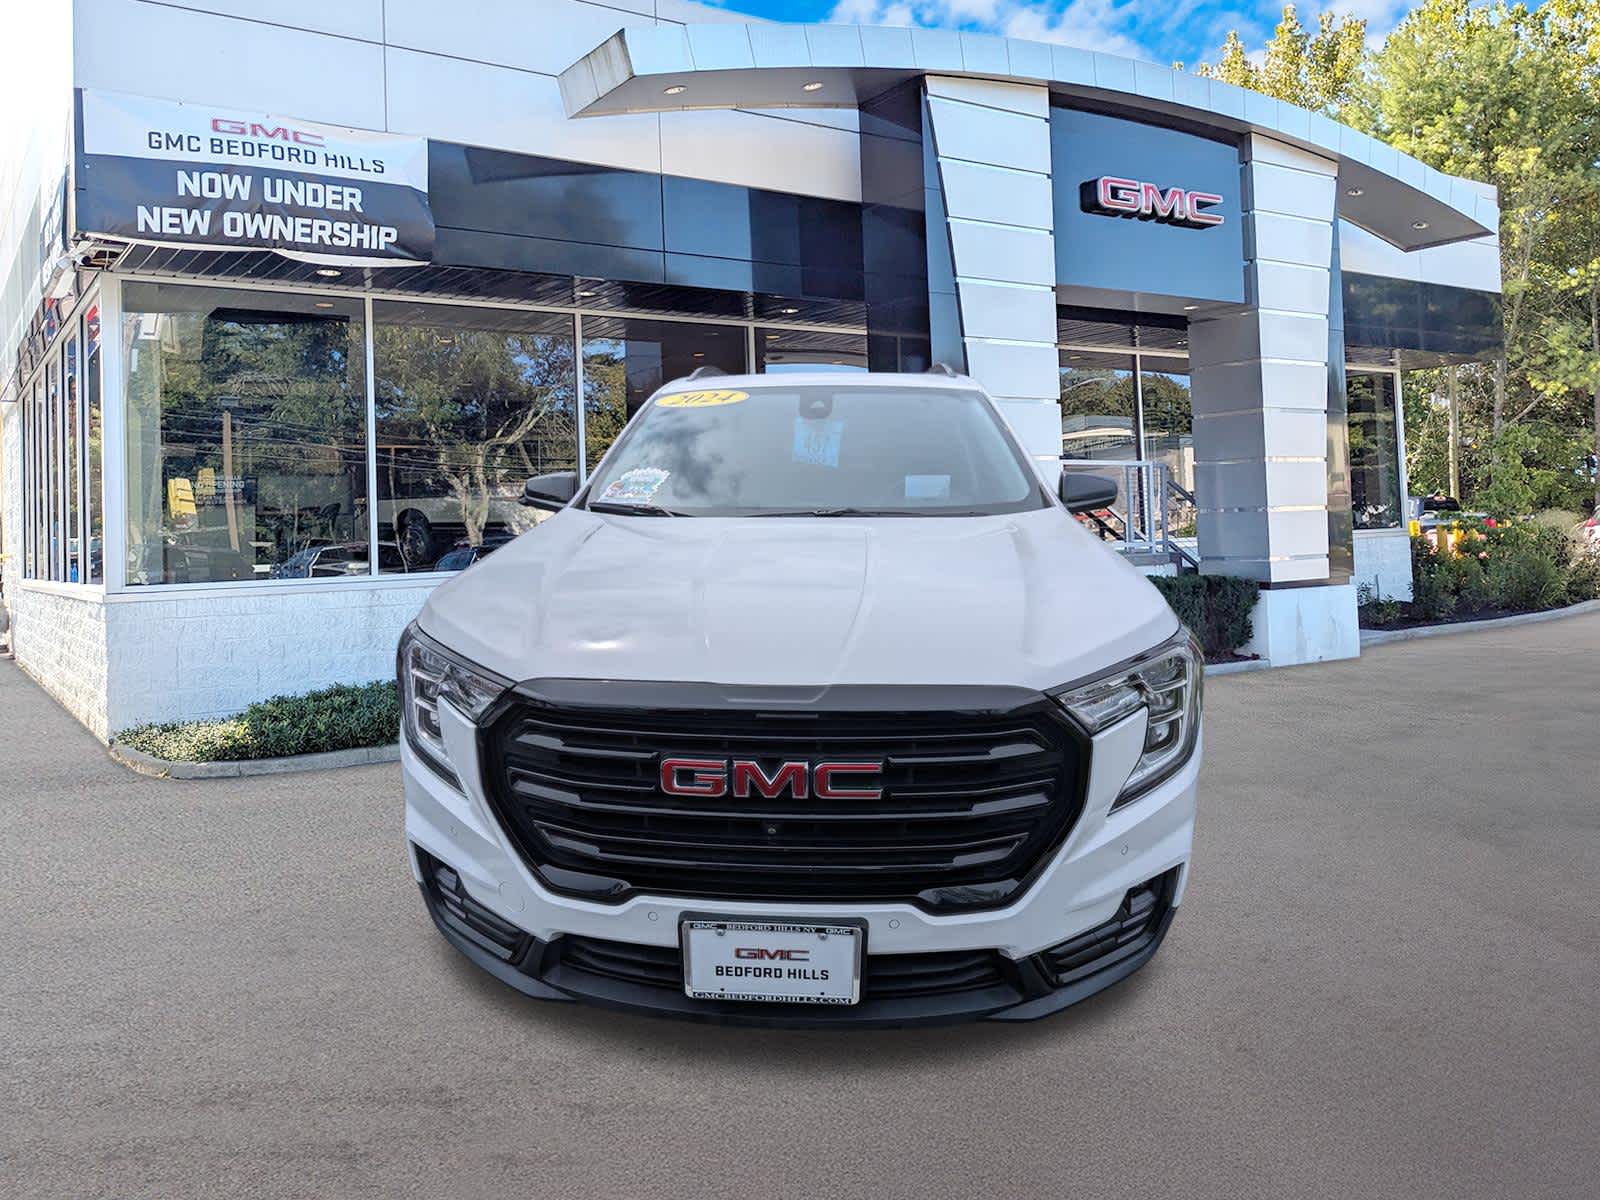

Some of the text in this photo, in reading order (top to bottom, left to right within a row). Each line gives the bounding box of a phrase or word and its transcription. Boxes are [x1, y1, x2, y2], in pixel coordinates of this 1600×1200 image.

[148, 131, 385, 174] GMC BEDFORD HILLS
[212, 118, 326, 148] GMC
[177, 170, 363, 213] NOW UNDER
[1097, 176, 1224, 224] GMC
[137, 206, 398, 250] NEW OWNERSHIP
[660, 758, 883, 799] GMC
[715, 965, 829, 980] BEDFORD HILLS
[735, 948, 810, 961] GMC
